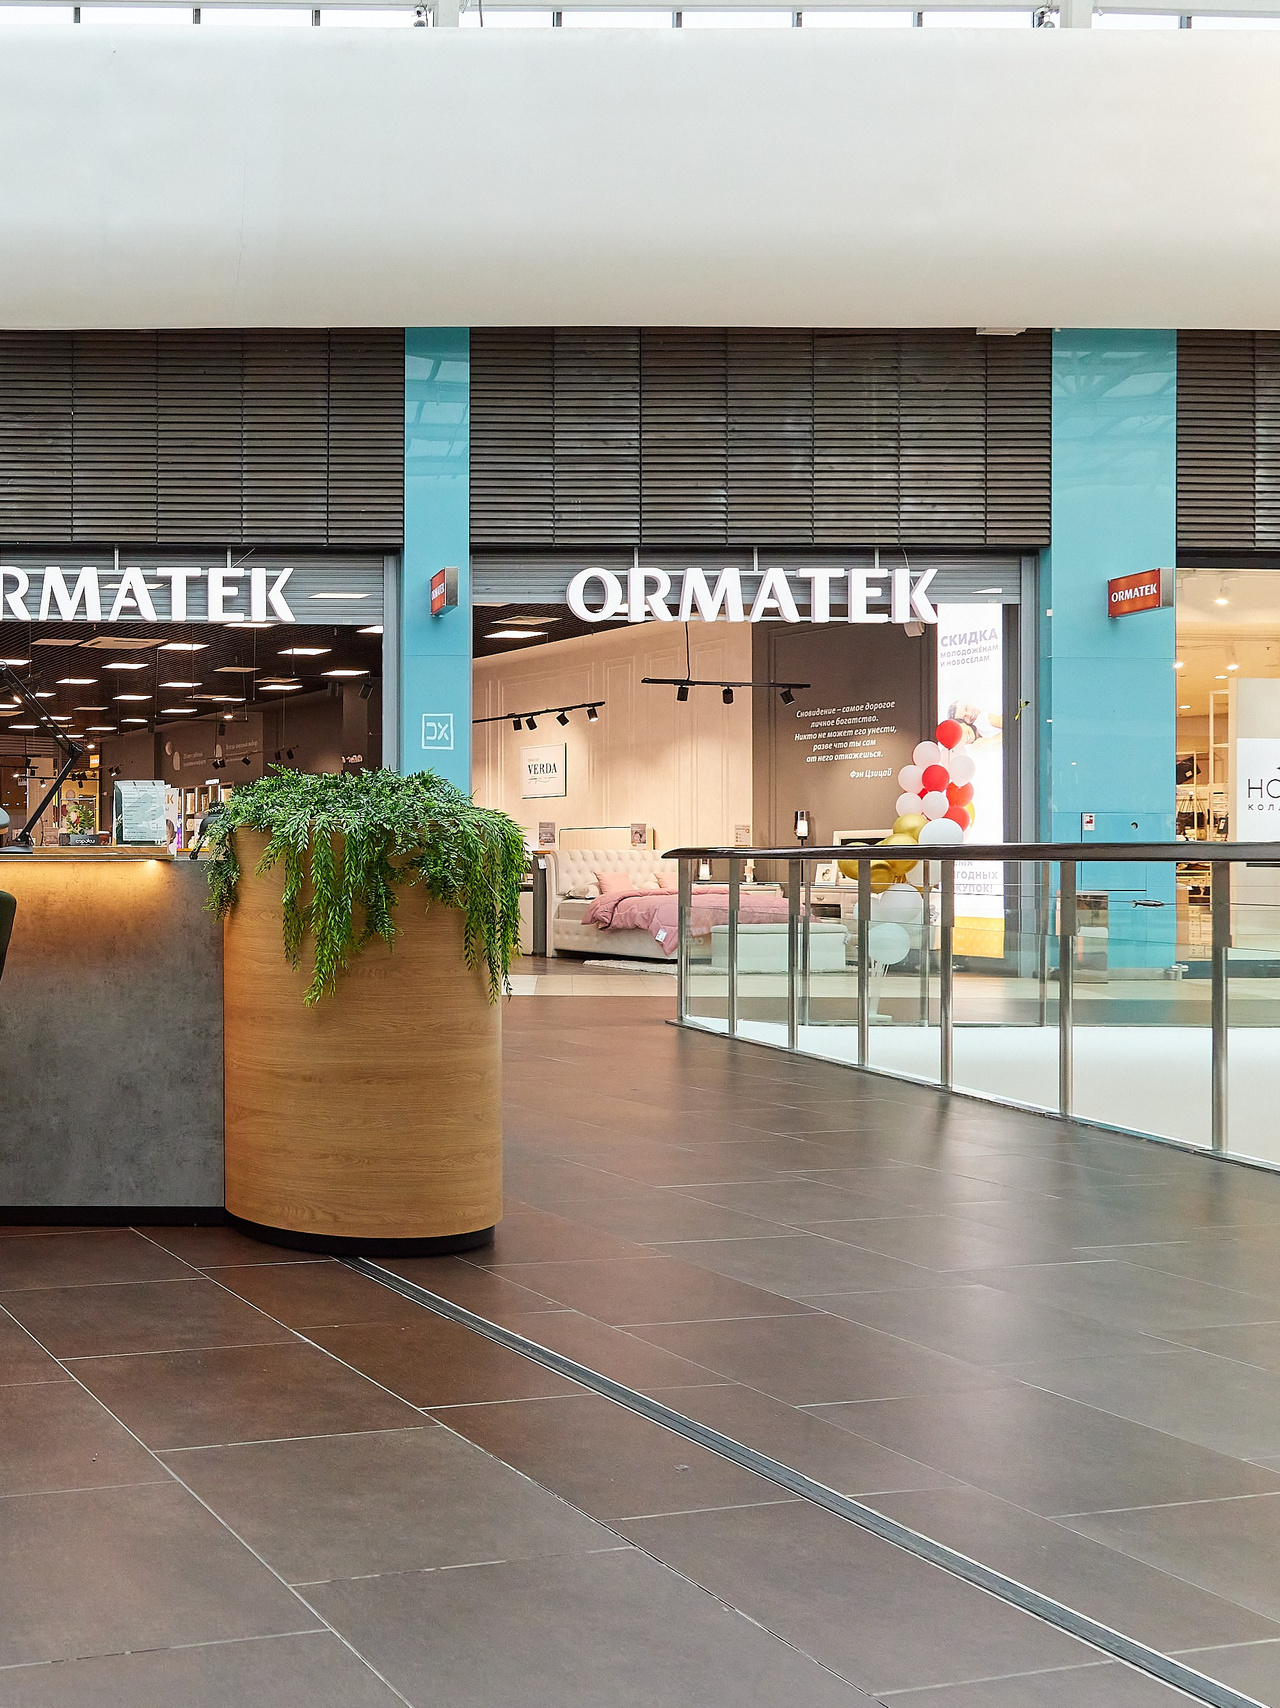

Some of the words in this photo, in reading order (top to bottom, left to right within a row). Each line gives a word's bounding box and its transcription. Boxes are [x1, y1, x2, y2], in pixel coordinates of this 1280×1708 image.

[565, 566, 939, 624] ORMATEK
[1111, 583, 1158, 603] ORMATEK
[940, 628, 998, 647] СКИДКА
[940, 644, 999, 659] МОЛОДОЖЁНАМ
[946, 655, 990, 667] НОВОСЁЛАМ
[796, 707, 837, 718] Сновидение
[842, 704, 865, 713] самое
[865, 701, 896, 711] дорогое
[810, 720, 835, 728] личное
[835, 714, 879, 725] богатство.
[794, 732, 817, 741] Никто
[818, 731, 827, 739] не
[827, 730, 854, 738] может
[854, 728, 867, 736] его
[867, 725, 897, 736] унести,
[813, 743, 833, 752] разве
[833, 741, 848, 749] что
[848, 740, 862, 748] ты
[862, 739, 877, 747] сам
[806, 755, 817, 763] от
[817, 754, 834, 762] него
[834, 750, 884, 761] откажешься.
[527, 762, 557, 775] VERDA
[849, 770, 864, 779] Фэн
